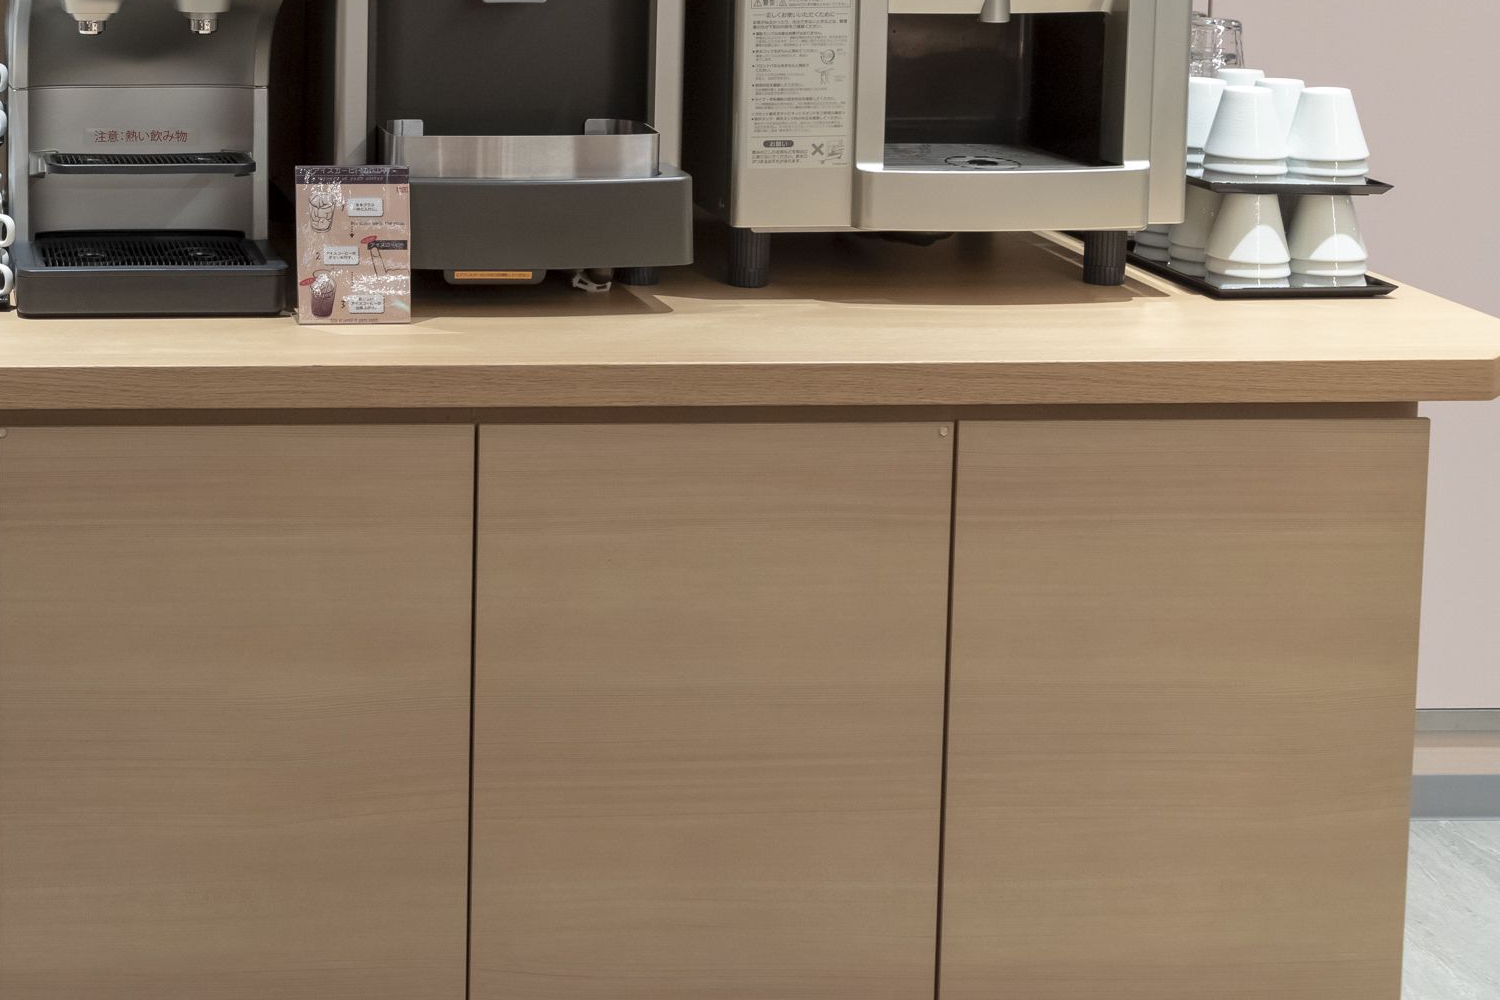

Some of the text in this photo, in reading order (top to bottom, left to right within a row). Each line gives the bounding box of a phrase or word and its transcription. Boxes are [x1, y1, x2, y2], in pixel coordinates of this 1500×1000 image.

[94, 130, 188, 143] 注意：熱い飲み物
